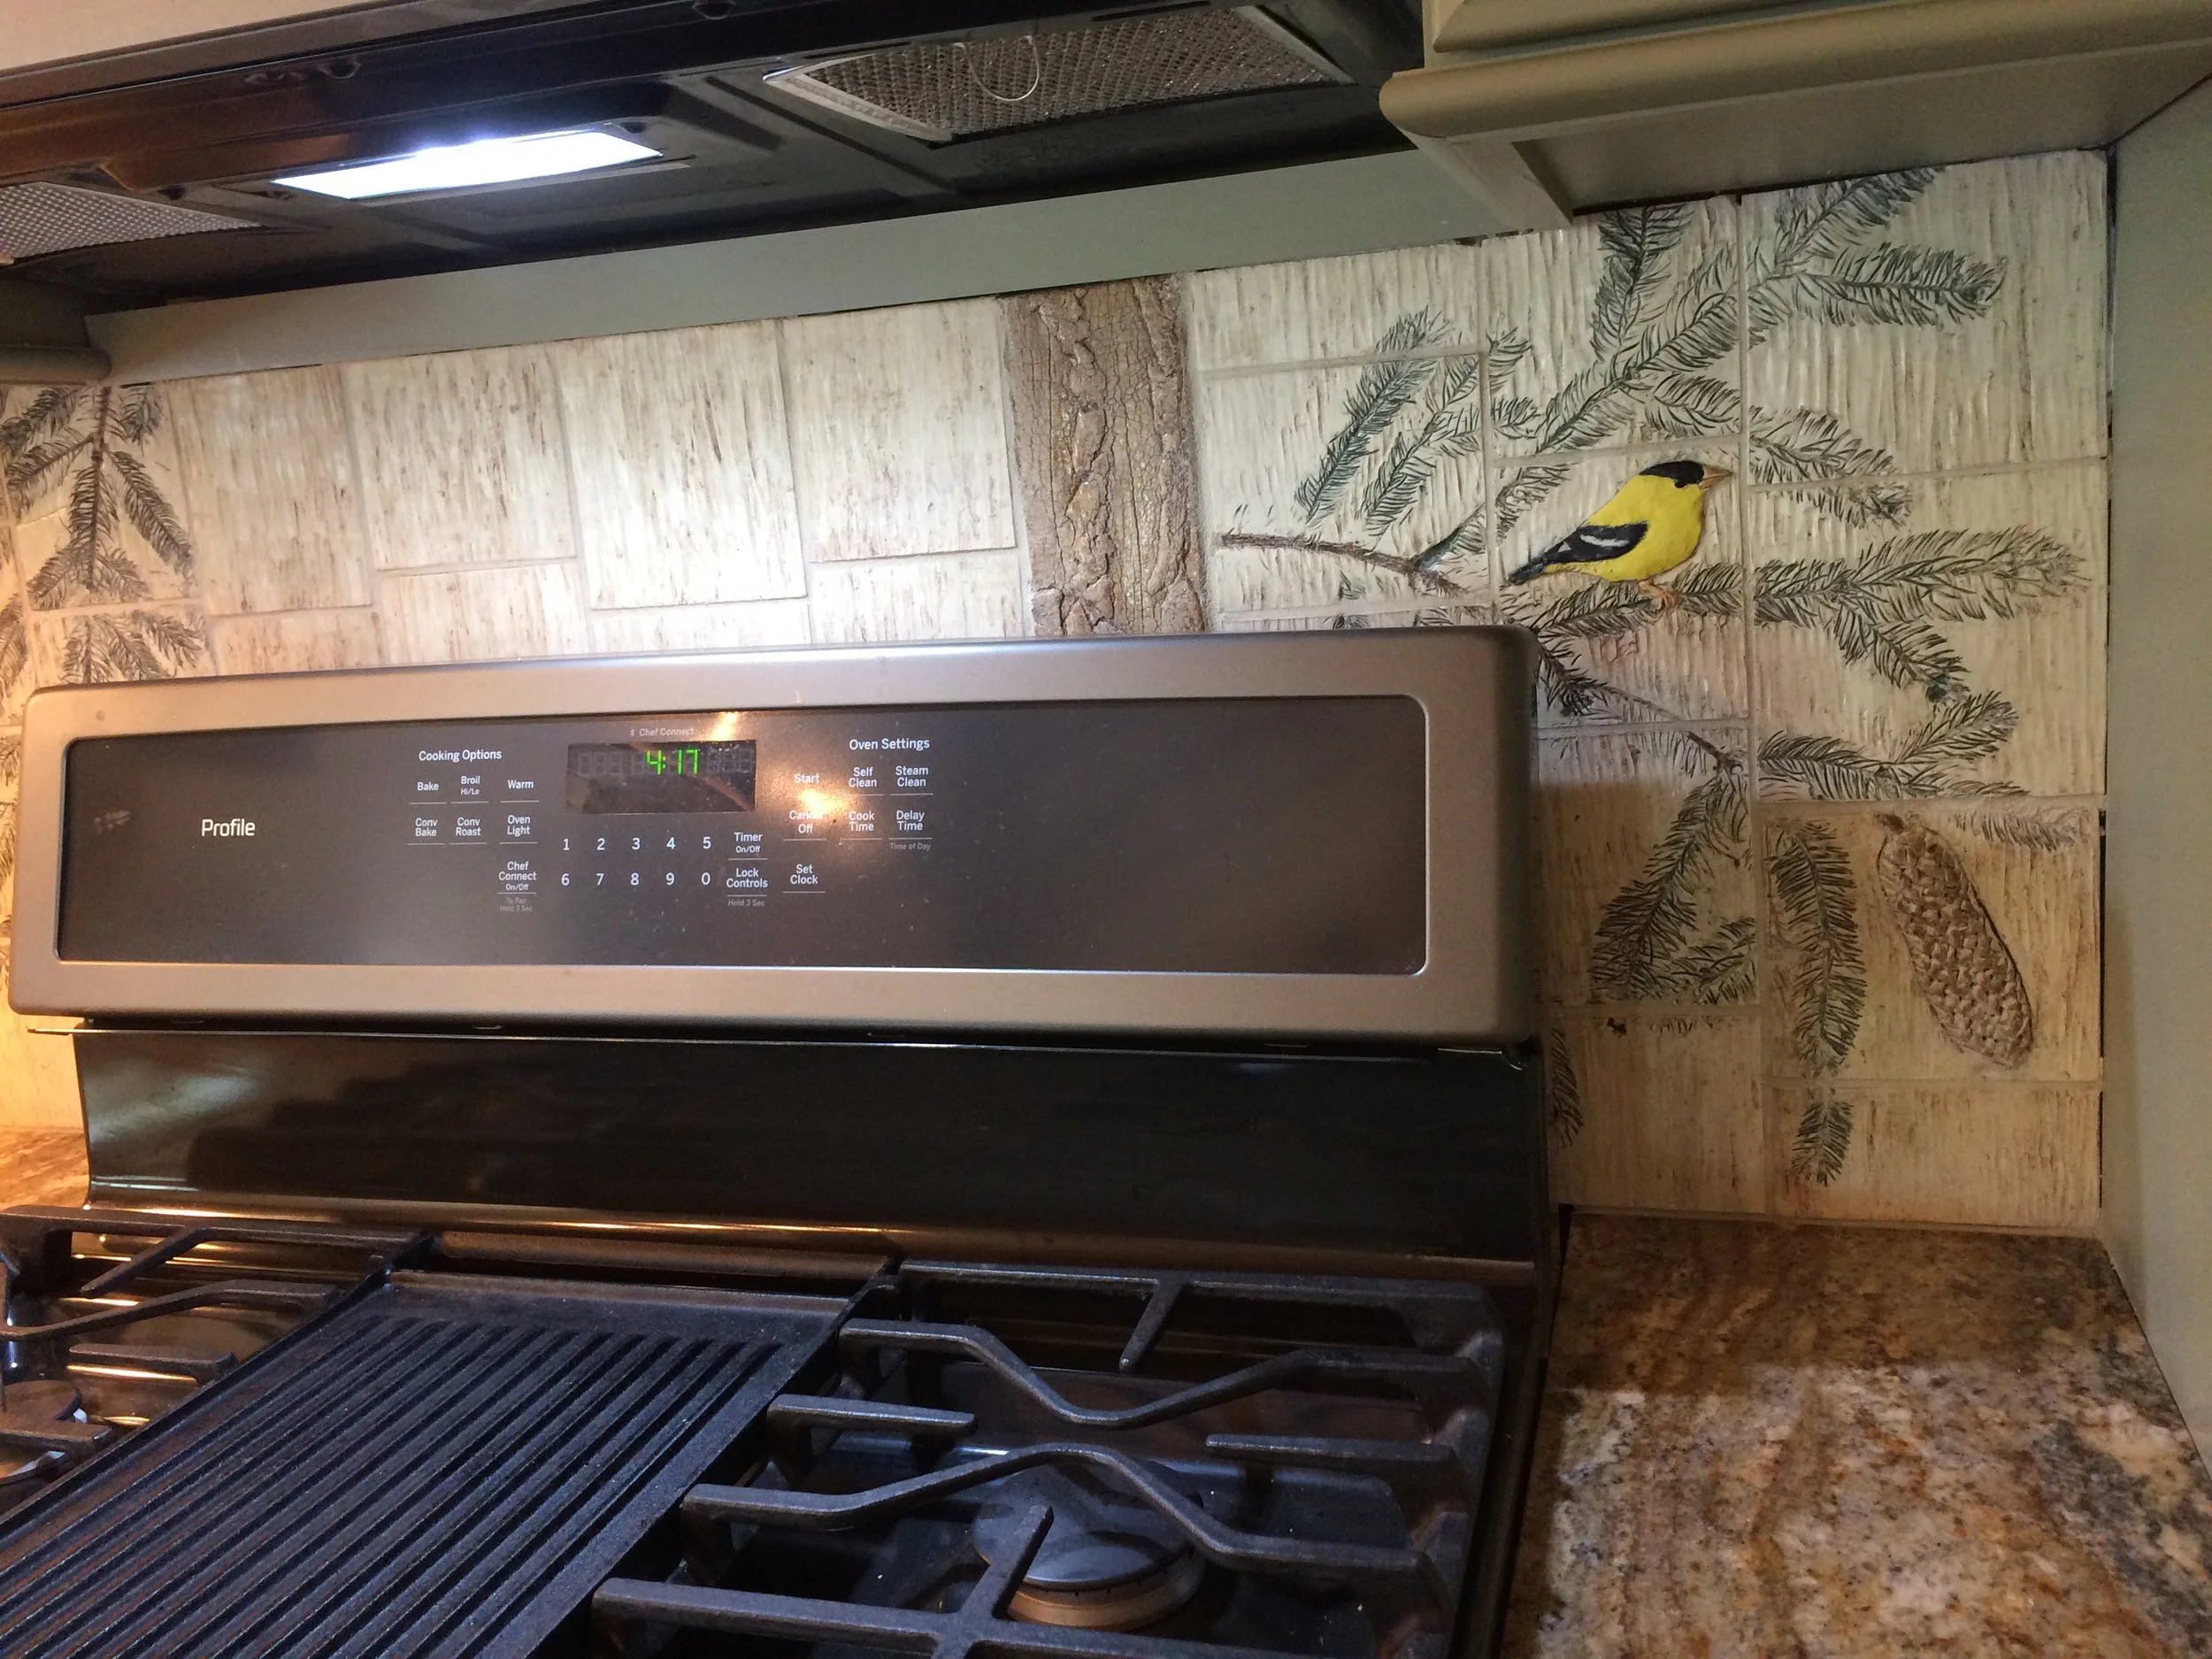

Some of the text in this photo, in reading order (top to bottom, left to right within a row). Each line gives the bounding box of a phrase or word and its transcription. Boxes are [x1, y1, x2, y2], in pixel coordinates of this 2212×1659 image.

[639, 727, 695, 737] Chef Connect
[849, 738, 931, 752] Oven Settings
[419, 749, 503, 763] Cooking Options
[646, 749, 698, 775] 4:17
[853, 766, 873, 777] Self
[895, 765, 929, 776] Steam
[460, 775, 480, 785] Broil
[794, 772, 820, 784] Start
[849, 777, 878, 787] Clean
[896, 776, 926, 787] Clean
[417, 781, 440, 791] Bake
[507, 780, 534, 790] Warm
[507, 815, 531, 825] Oven
[789, 810, 824, 820] Canc
[849, 810, 875, 821] Cook
[895, 810, 925, 824] Delay
[415, 818, 438, 827] Conv
[457, 817, 480, 827] Conv
[849, 821, 874, 832] Time
[896, 821, 923, 832] Time
[201, 818, 256, 837] Profile
[415, 827, 437, 837] Bake
[455, 826, 481, 836] Roast
[507, 825, 531, 837] Light
[798, 823, 814, 833] Off
[733, 832, 763, 842] Timer
[563, 837, 711, 850] 1 2 3 4 5
[916, 842, 931, 852] Day
[735, 845, 761, 854] On/Off
[507, 861, 529, 871] Chef
[795, 864, 813, 874] Set
[498, 871, 537, 881] Connect
[735, 867, 759, 878] Lock
[561, 872, 710, 886] 6 7 8 9 0
[726, 878, 768, 889] Controls
[790, 874, 818, 885] Clock
